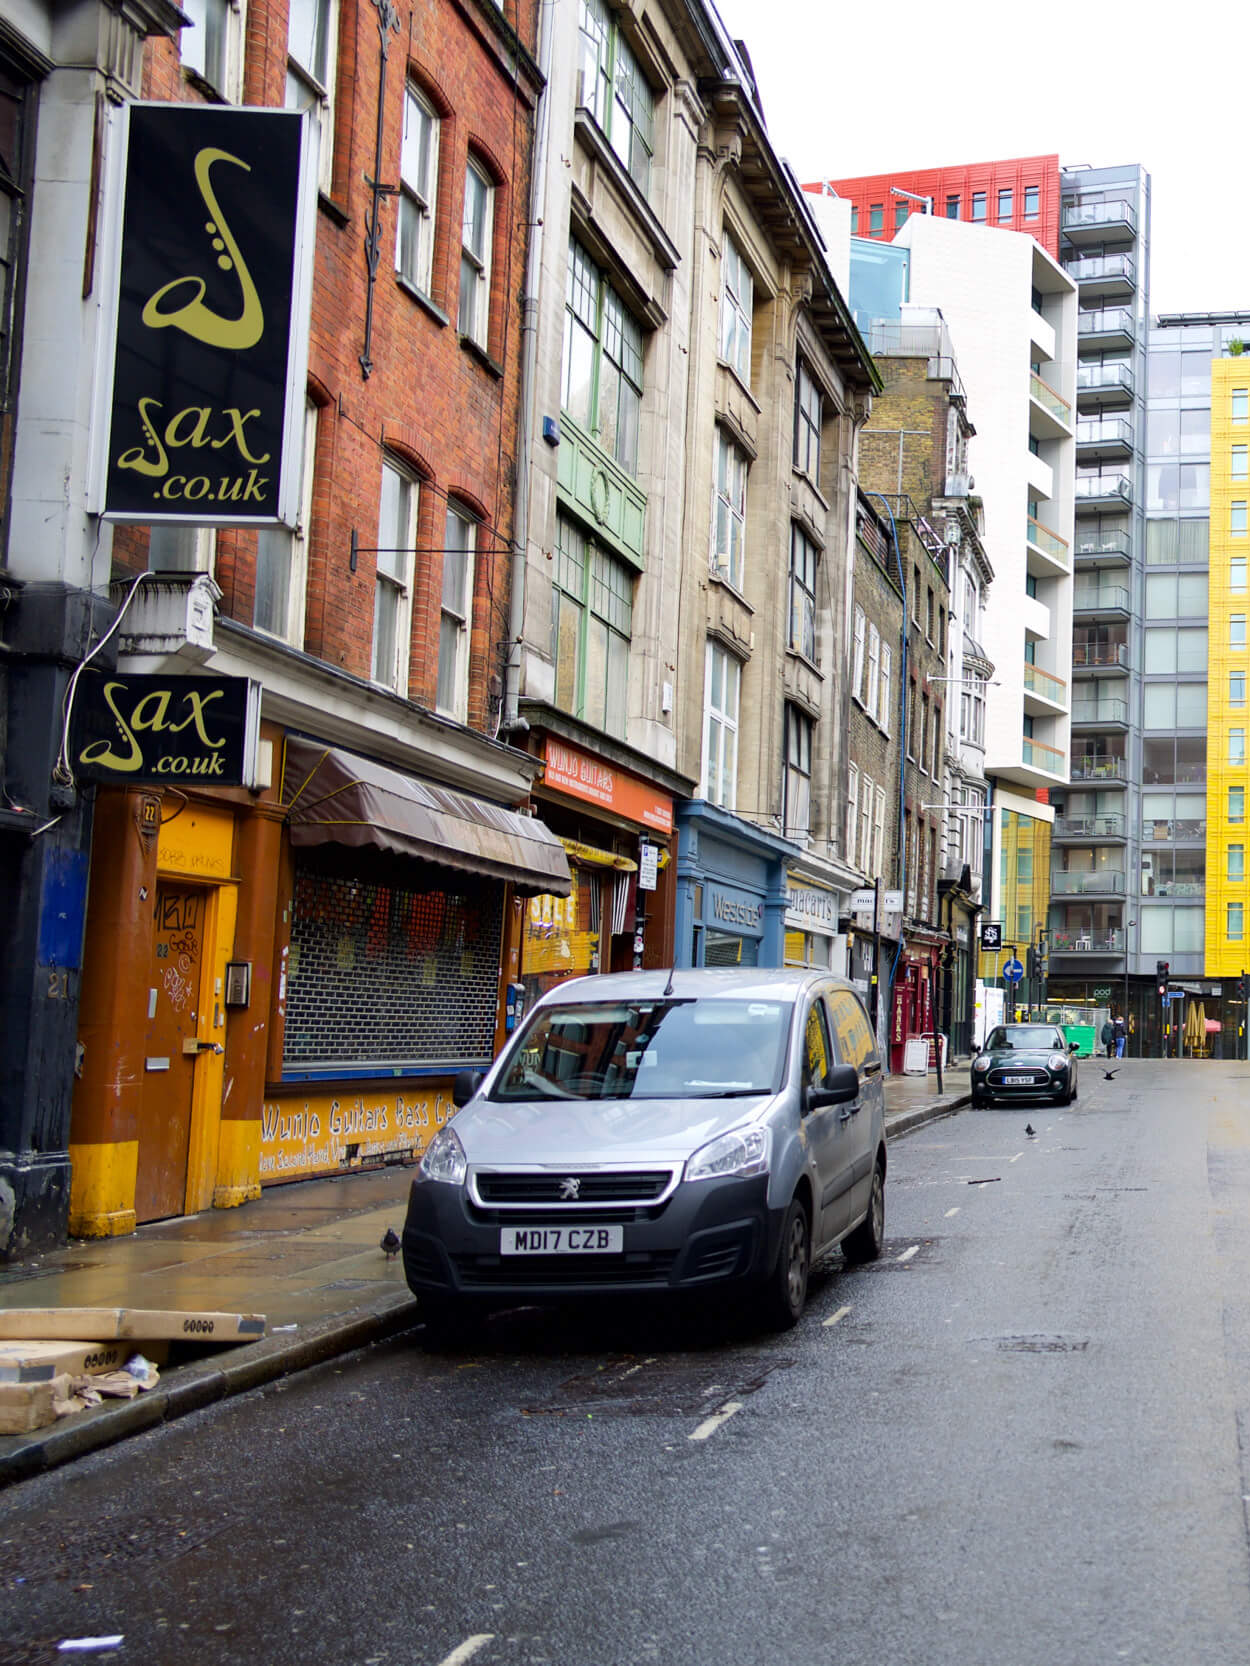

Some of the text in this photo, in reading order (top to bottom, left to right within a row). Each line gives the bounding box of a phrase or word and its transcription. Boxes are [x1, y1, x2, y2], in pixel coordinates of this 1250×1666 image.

[117, 397, 270, 477] Sax
[153, 469, 270, 501] .co.uk
[79, 682, 226, 772] Sax
[151, 752, 226, 775] .co.uk
[548, 743, 578, 778] WUNJO
[580, 760, 613, 793] GUITARS
[531, 895, 575, 924] SALE
[713, 891, 759, 928] Westside
[48, 973, 69, 998] 21
[1093, 988, 1111, 997] pod
[262, 1104, 320, 1143] Wunjo
[329, 1098, 388, 1136] Guitars
[396, 1096, 428, 1128] Bass
[515, 1229, 609, 1251] MD17 CZB
